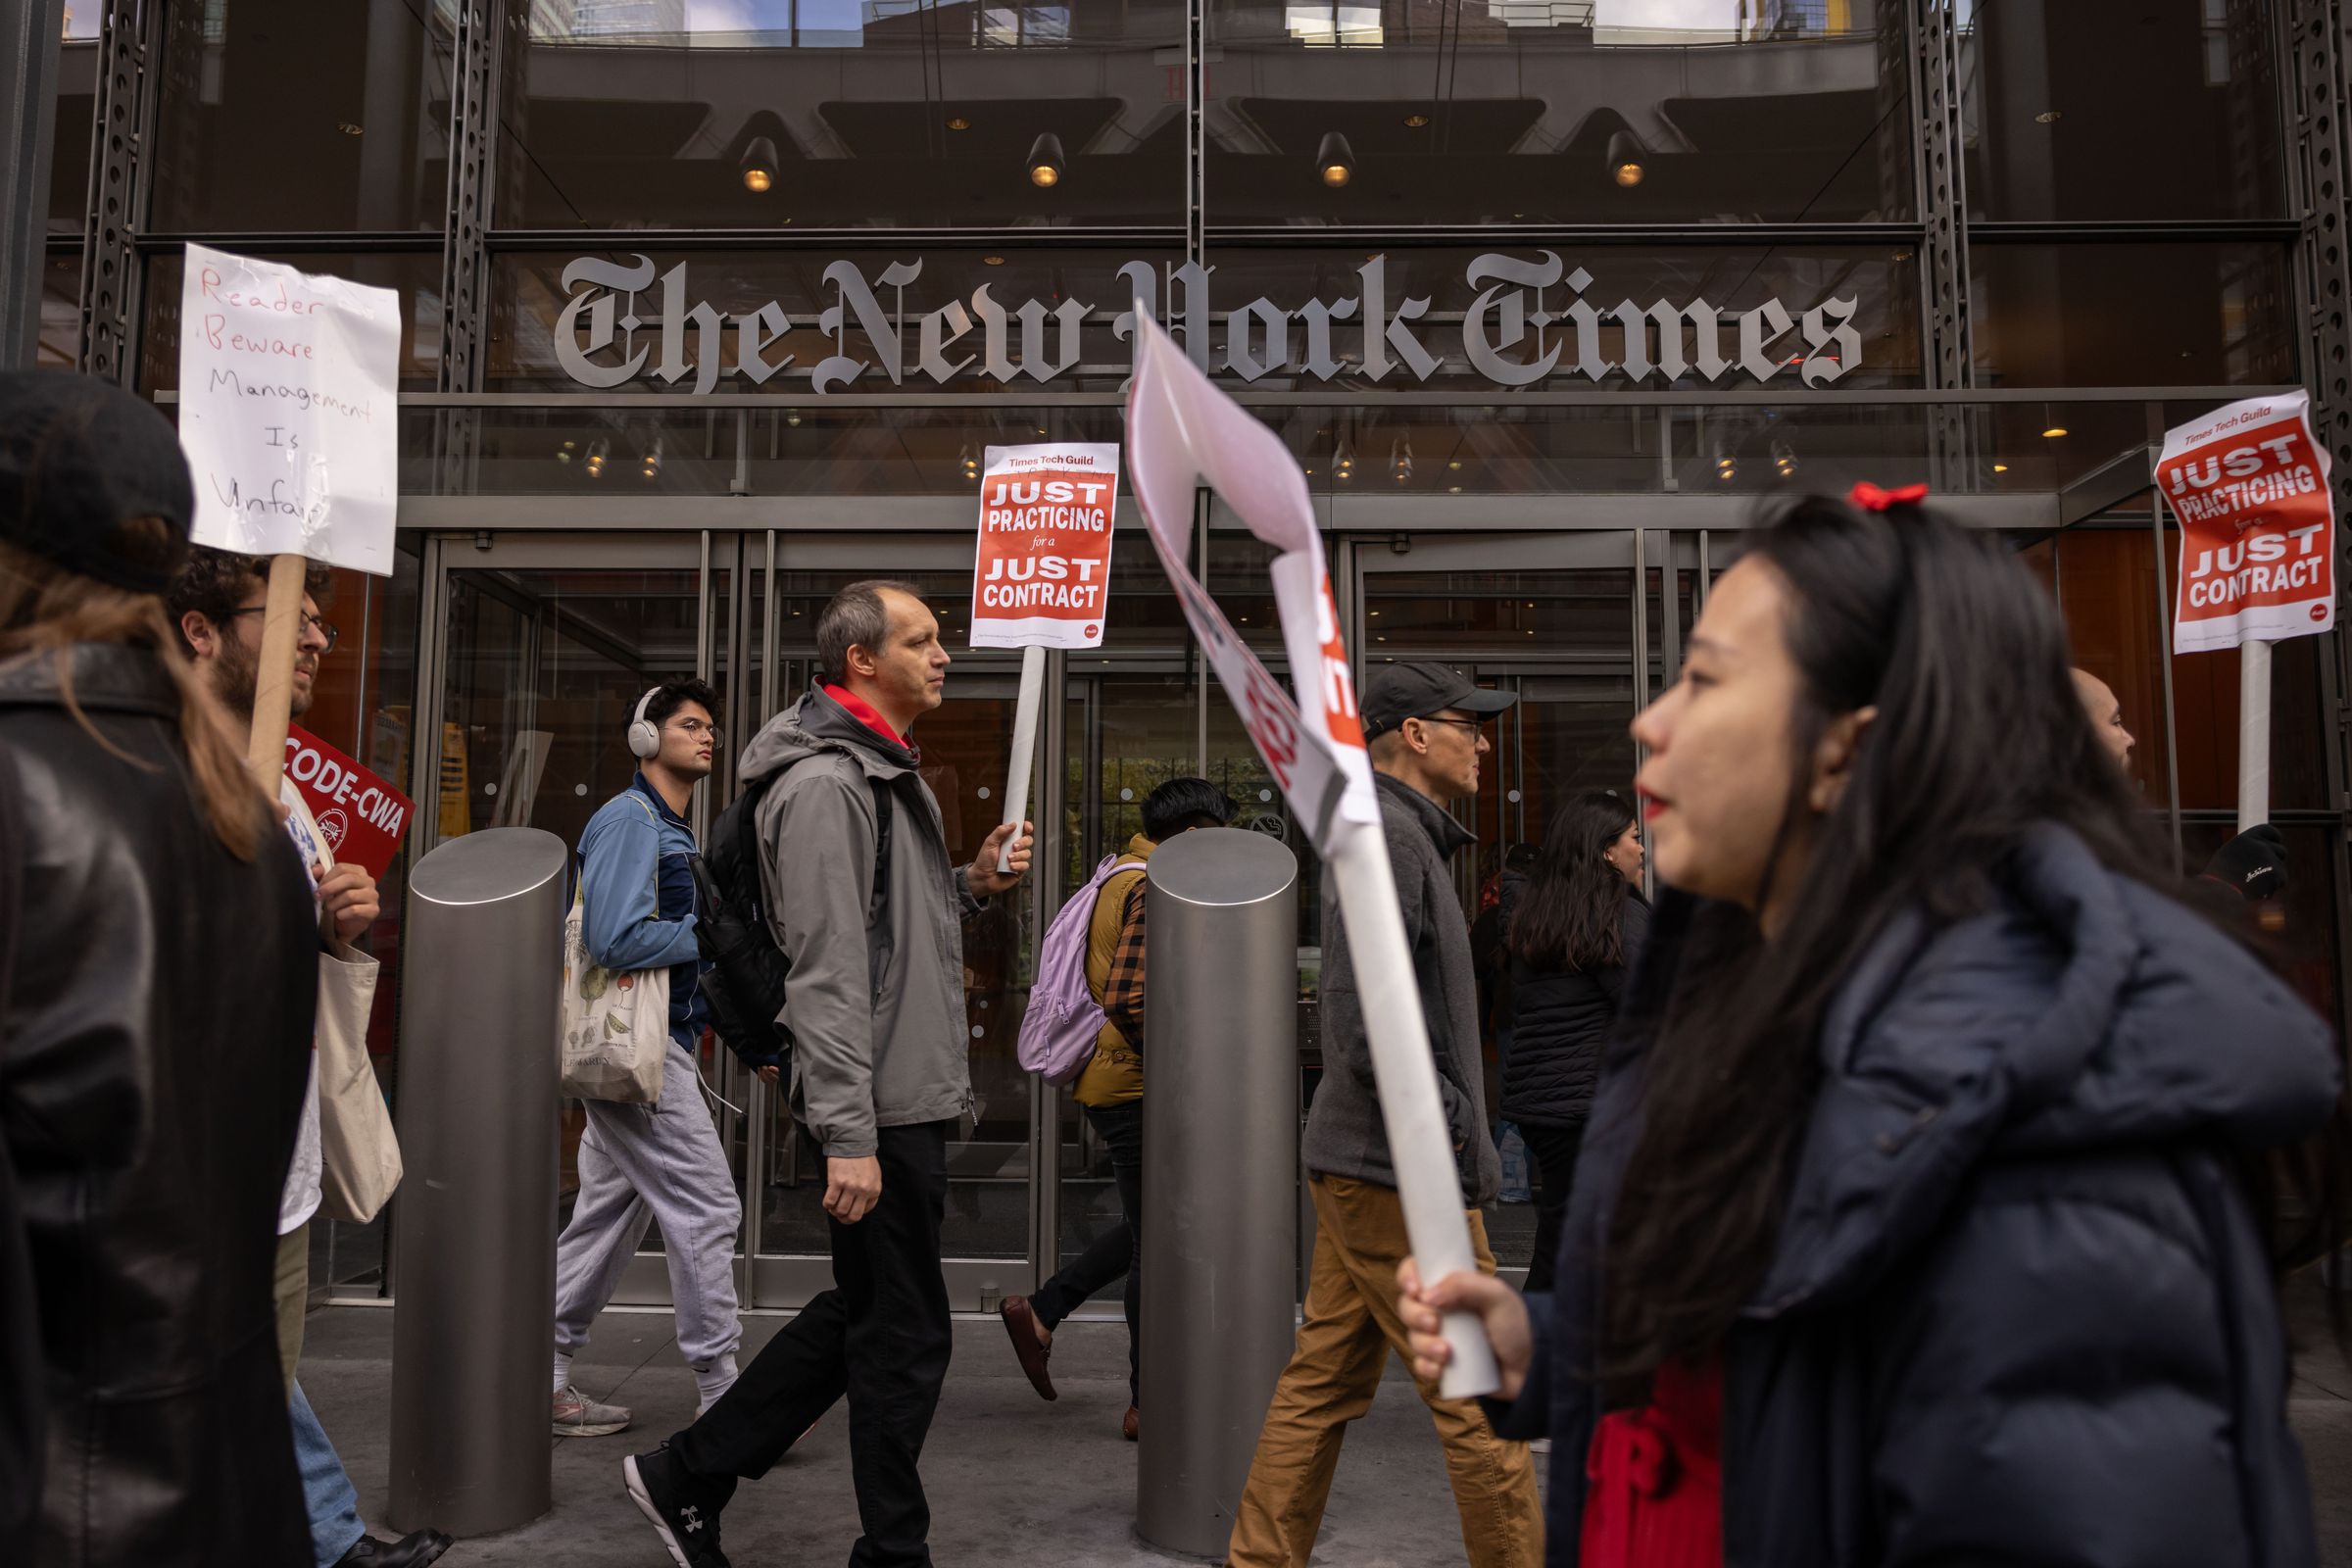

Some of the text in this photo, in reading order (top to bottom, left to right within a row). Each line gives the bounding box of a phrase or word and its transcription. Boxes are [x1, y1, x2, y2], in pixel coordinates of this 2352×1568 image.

[202, 268, 324, 315] Reader
[205, 315, 314, 360] Beware
[555, 249, 1862, 418] The New York Times
[210, 368, 371, 423] Management
[265, 427, 299, 450] Is
[2185, 406, 2272, 446] Times Tech Guild
[1009, 455, 1094, 467] Times Tech Guild
[2169, 433, 2298, 496] JUST
[990, 481, 1107, 507] JUST
[2177, 465, 2317, 523] PRACTICING
[988, 506, 1104, 533] PRACTICING
[1030, 535, 1048, 551] for
[2189, 523, 2324, 578] JUST
[984, 556, 1102, 581] JUST
[2188, 556, 2323, 608] CONTRACT
[983, 582, 1099, 608] CONTRACT
